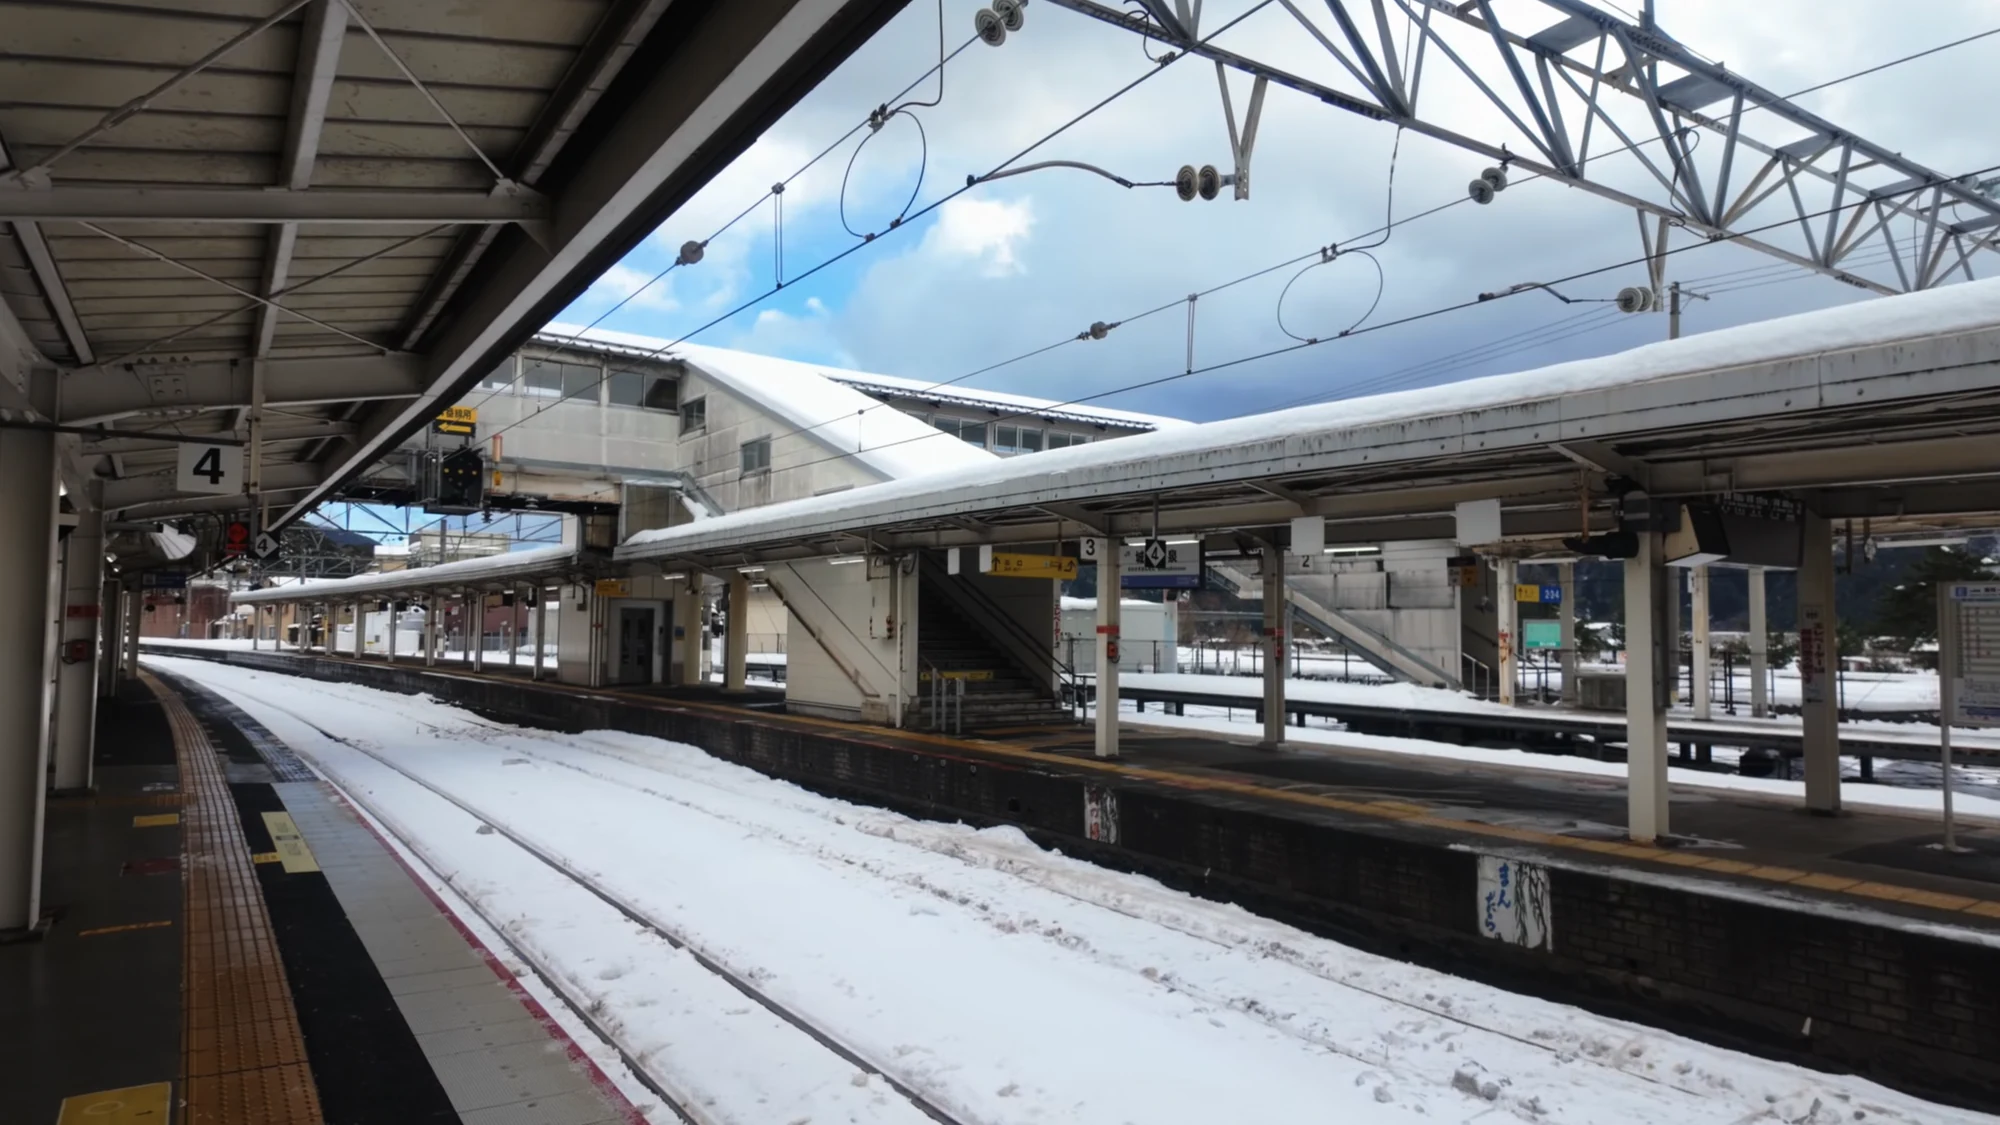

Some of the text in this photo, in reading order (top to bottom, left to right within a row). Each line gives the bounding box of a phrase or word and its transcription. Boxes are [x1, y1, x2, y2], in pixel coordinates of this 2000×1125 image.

[193, 447, 225, 485] 4
[257, 538, 268, 552] 4
[1085, 538, 1095, 556] 3
[1150, 546, 1159, 560] 4
[1302, 555, 1310, 568] 2
